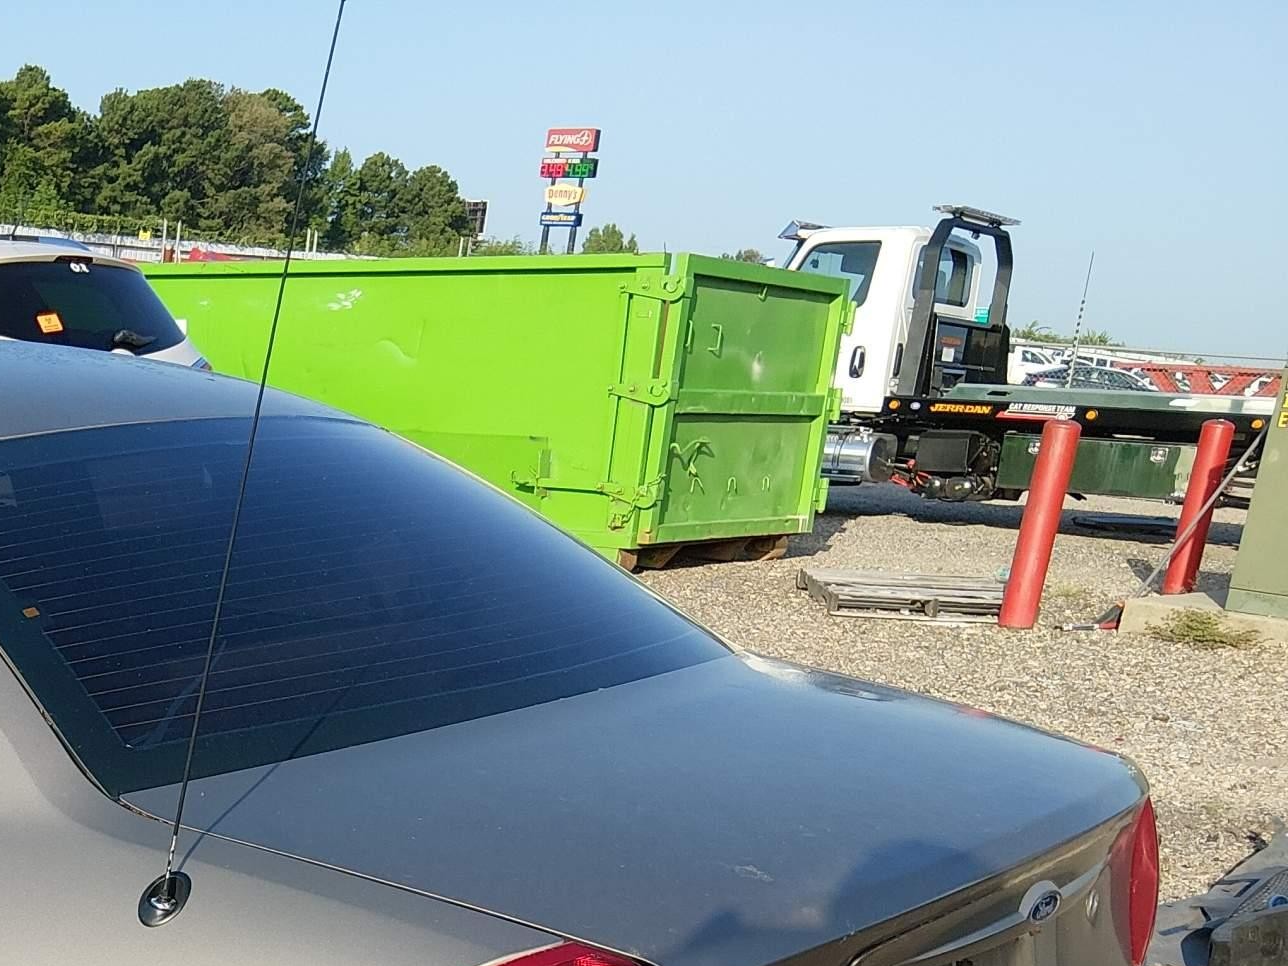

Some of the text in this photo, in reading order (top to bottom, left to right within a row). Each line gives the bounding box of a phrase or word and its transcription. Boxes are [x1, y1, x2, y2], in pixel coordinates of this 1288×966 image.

[549, 134, 579, 145] FLYING
[548, 189, 578, 200] Denny's
[1008, 402, 1076, 413] CAT RESPONSE TEAM
